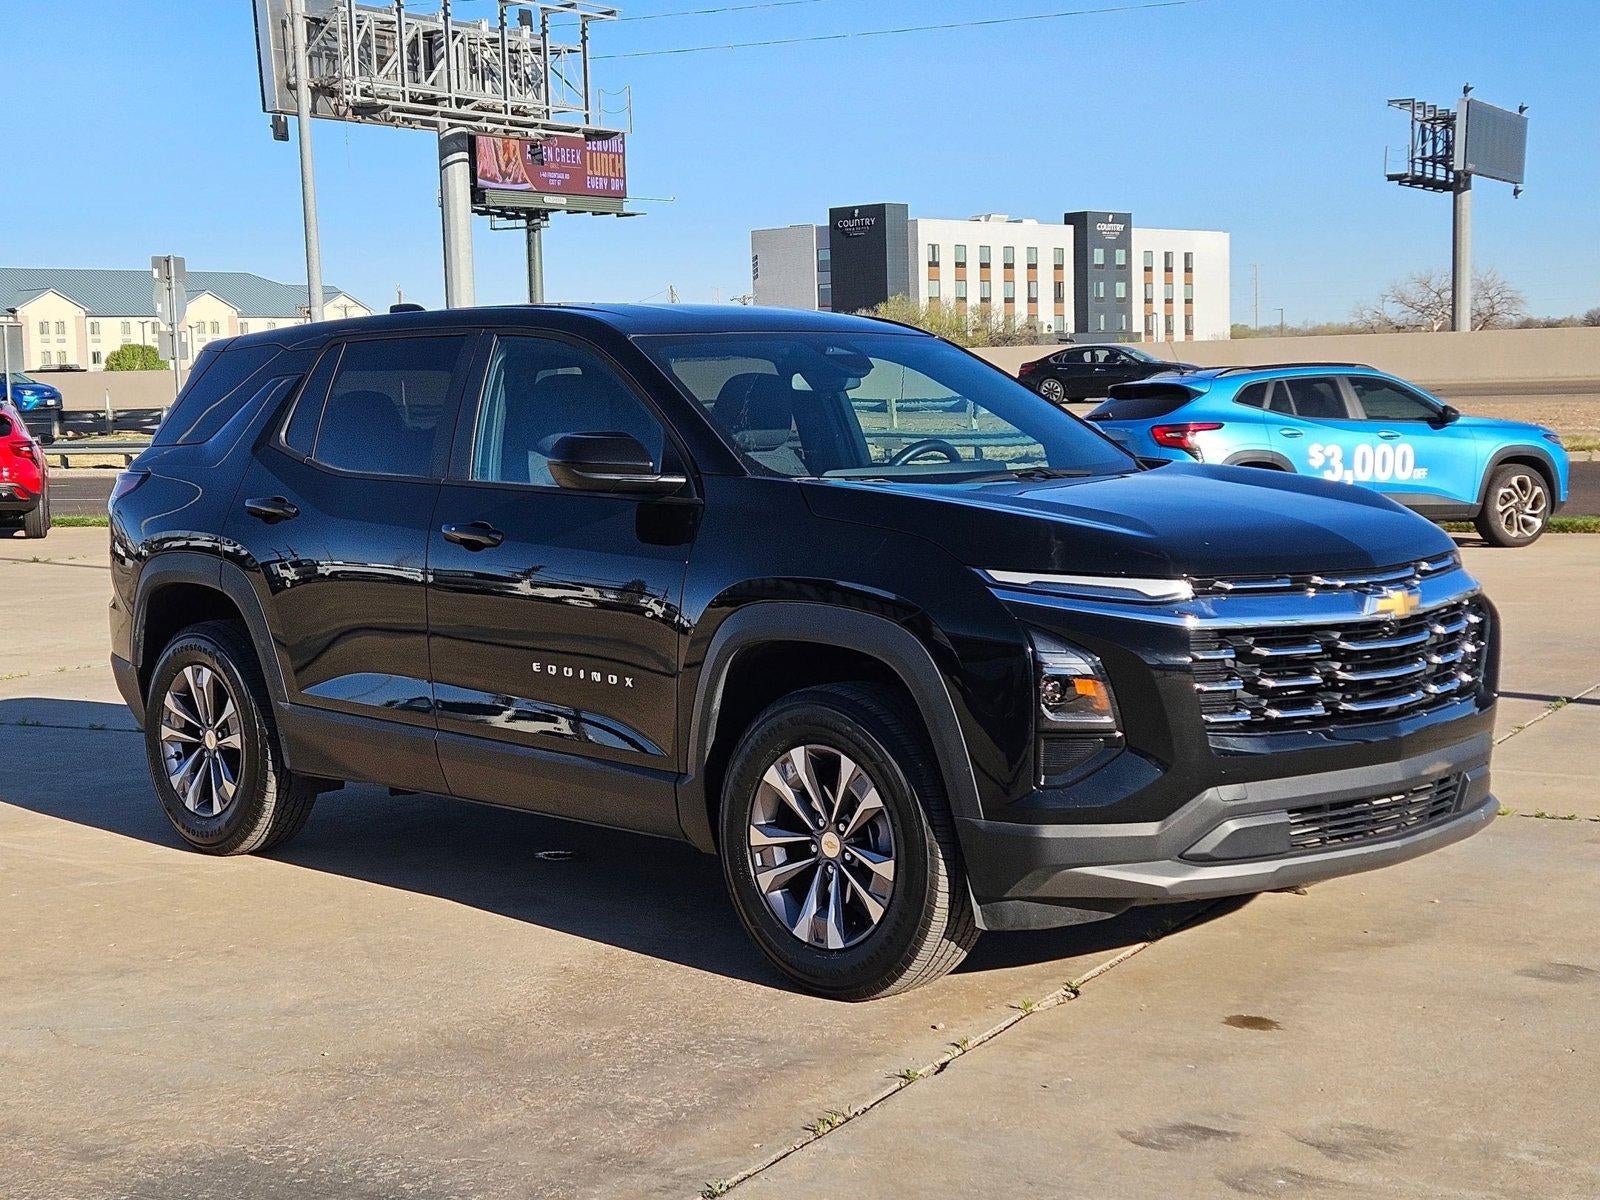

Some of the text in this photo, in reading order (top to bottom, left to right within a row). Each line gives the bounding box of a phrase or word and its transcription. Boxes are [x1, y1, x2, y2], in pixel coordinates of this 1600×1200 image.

[526, 144, 581, 164] AEN CREEK
[586, 152, 623, 177] LUNCH
[587, 176, 623, 190] EVERY DAY
[838, 217, 876, 228] COUNTRY
[1096, 223, 1125, 231] COUNTRY
[1308, 442, 1414, 485] $3,000
[532, 662, 634, 688] EQUINOX
